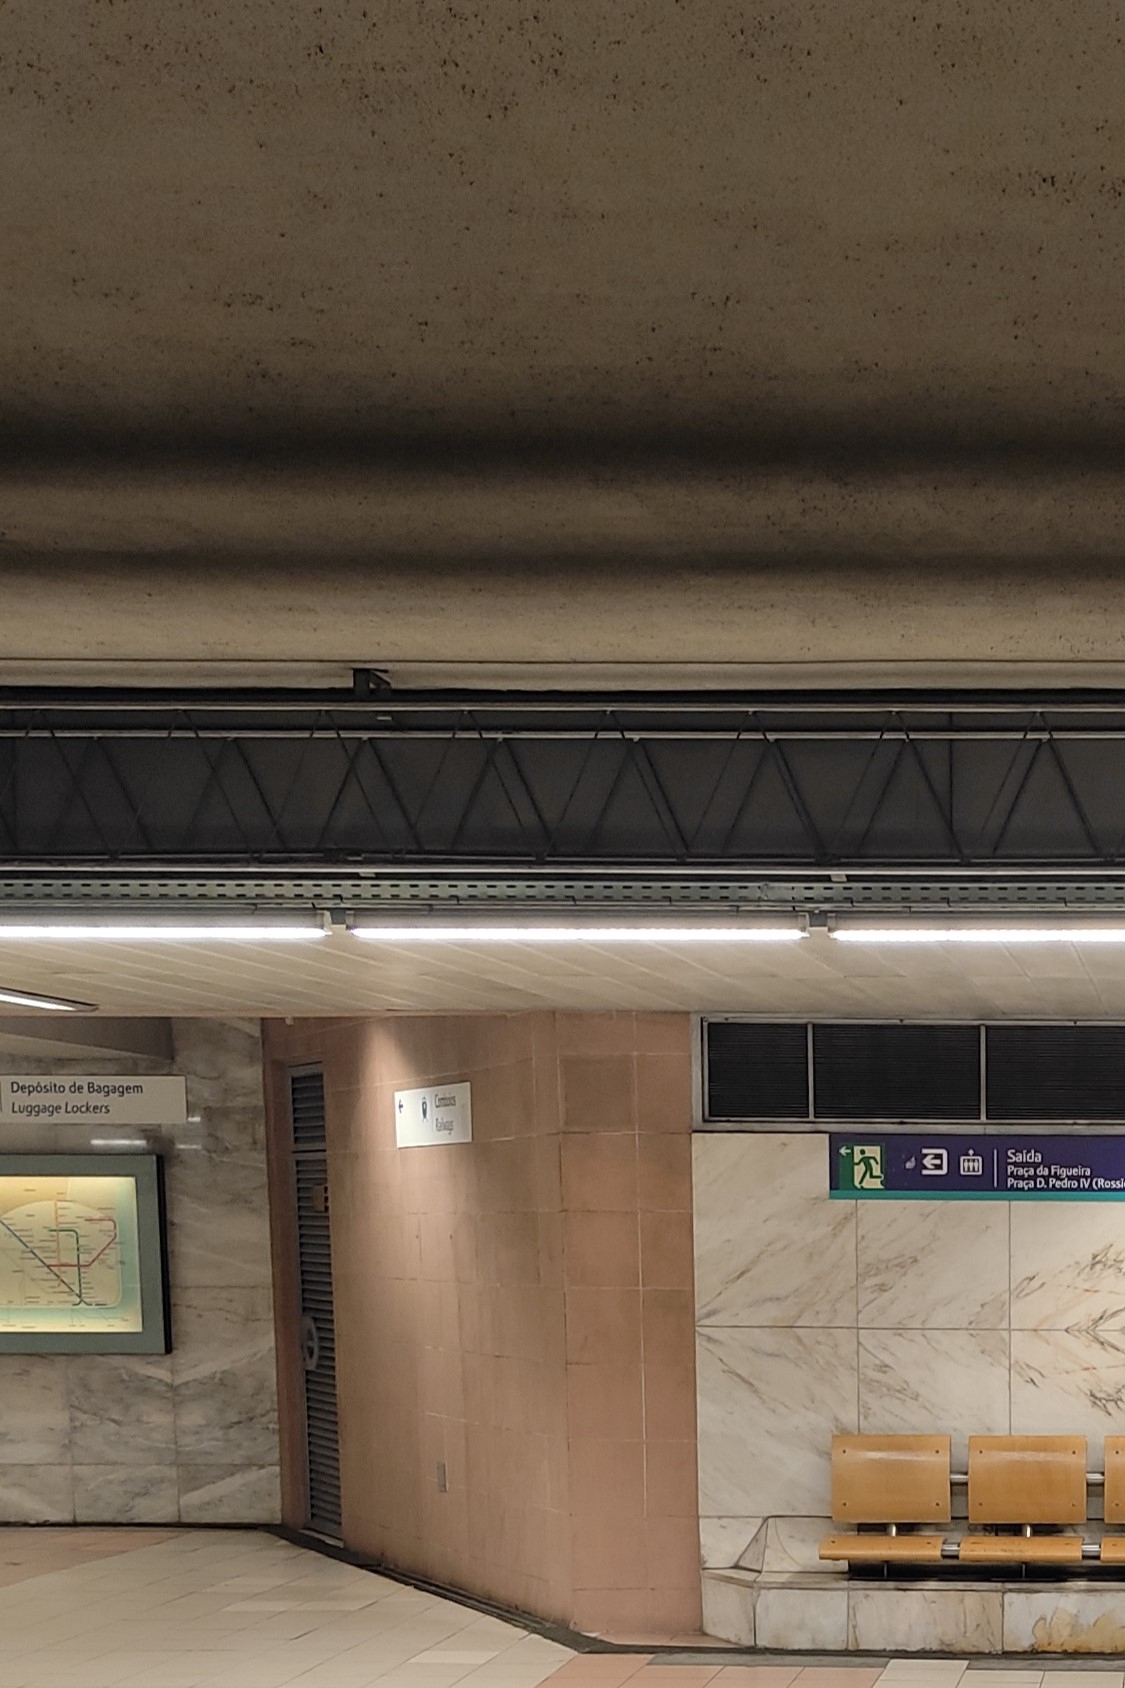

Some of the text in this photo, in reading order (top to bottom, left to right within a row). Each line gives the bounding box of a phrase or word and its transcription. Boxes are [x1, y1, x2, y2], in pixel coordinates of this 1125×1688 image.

[10, 1081, 144, 1097] Depósito de Bagagem
[11, 1101, 110, 1117] Luggage Lockers
[1006, 1149, 1042, 1163] Saída
[1007, 1165, 1091, 1178] Praça da Figueira
[1007, 1178, 1034, 1190] Praça
[1036, 1178, 1047, 1189] D.
[1048, 1178, 1078, 1189] Pedro
[1080, 1178, 1091, 1188] IV
